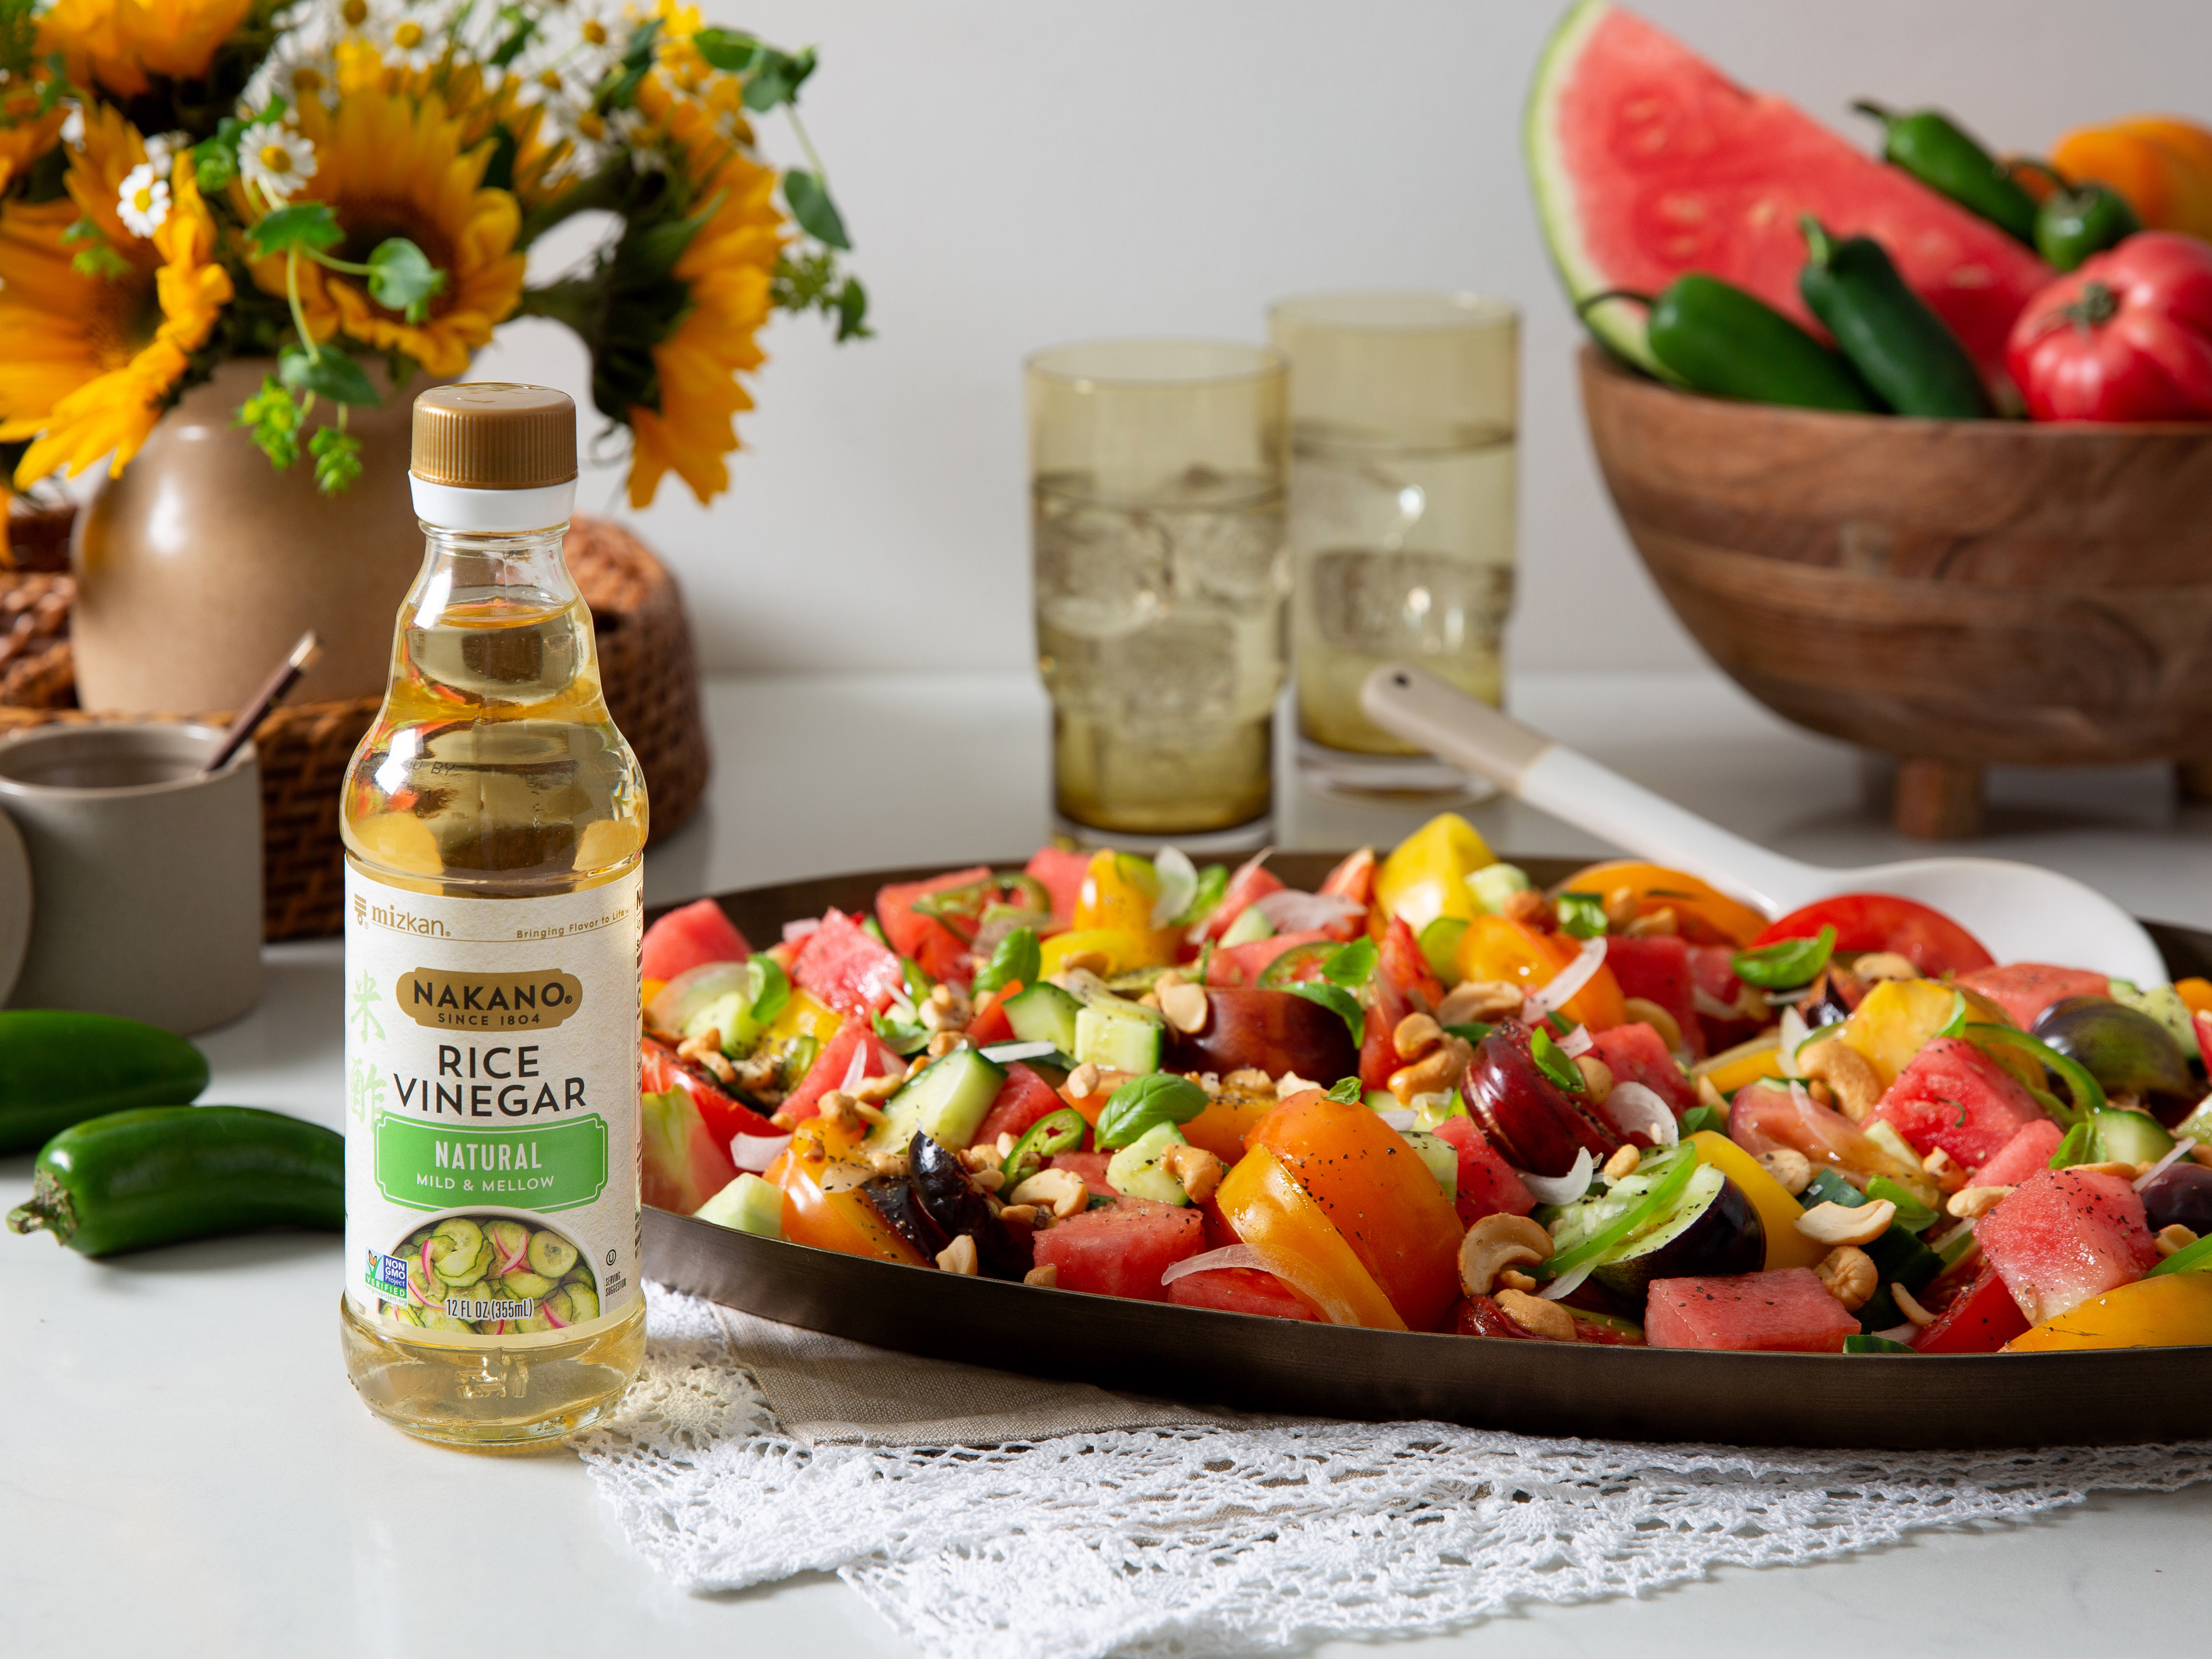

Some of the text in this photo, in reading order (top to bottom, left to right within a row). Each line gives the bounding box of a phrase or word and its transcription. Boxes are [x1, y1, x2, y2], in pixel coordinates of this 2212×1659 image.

[516, 927, 564, 939] Bringing
[569, 920, 598, 932] Flavor
[601, 916, 609, 925] to
[438, 1013, 540, 1026] SINCE 1804
[439, 1045, 539, 1080] RICE
[393, 1073, 586, 1117] VINEGAR
[435, 1141, 542, 1171] NATURAL
[416, 1173, 554, 1191] MILD & MELLOW
[385, 1257, 405, 1271] NON
[385, 1267, 405, 1280] GMO
[366, 1275, 405, 1297] VERIFIED
[385, 1275, 405, 1287] Project
[605, 1271, 621, 1286] SERVING
[605, 1277, 626, 1297] SUGGESTION
[447, 1298, 533, 1320] 12 FL OZ (355mL)
